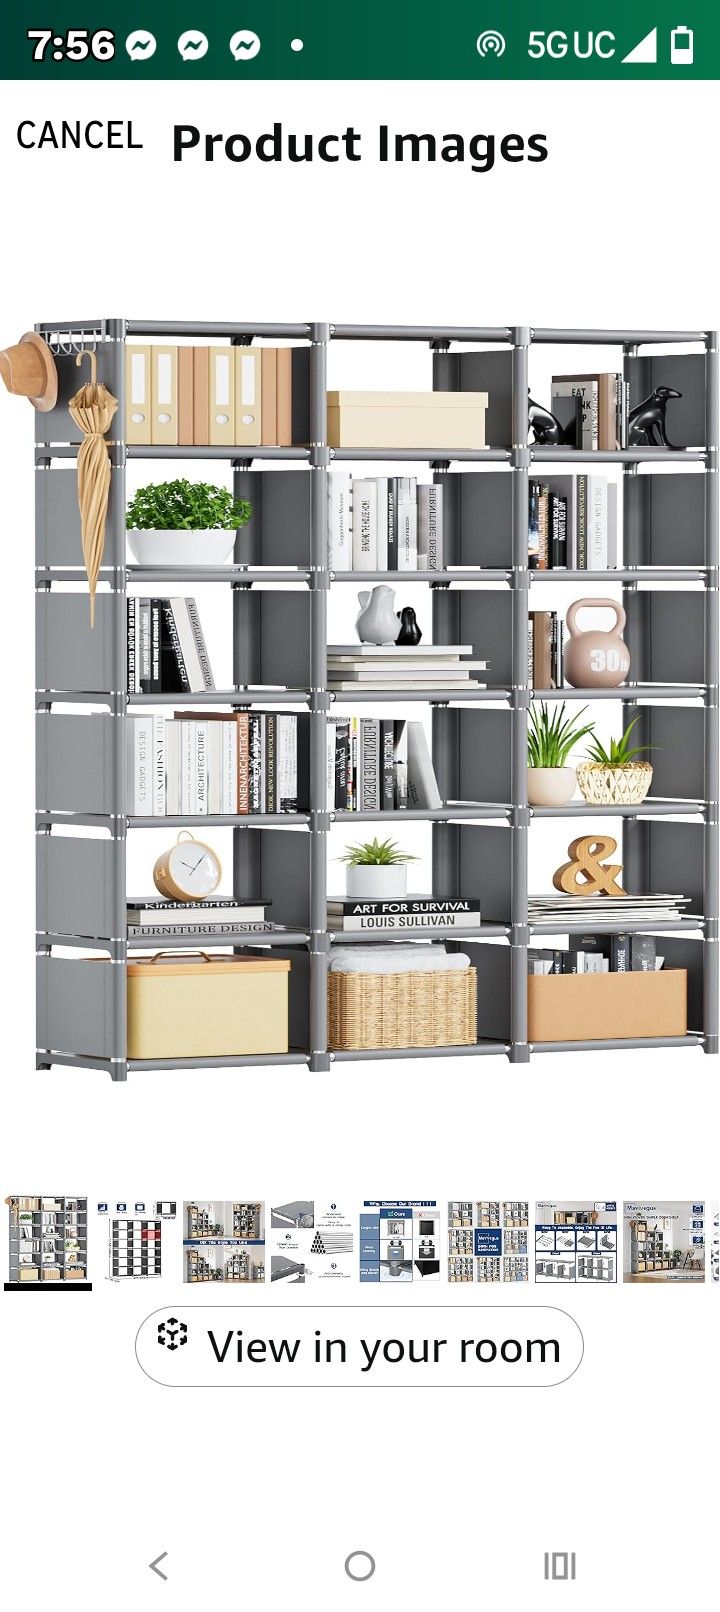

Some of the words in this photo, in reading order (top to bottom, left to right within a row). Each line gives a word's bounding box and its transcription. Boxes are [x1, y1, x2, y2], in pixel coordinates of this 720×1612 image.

[27, 28, 115, 62] 7:56
[16, 120, 143, 149] CANCEL
[172, 124, 361, 163] Product
[378, 125, 549, 172] Images
[571, 388, 586, 397] EAT
[590, 649, 620, 672] 30
[240, 716, 248, 811] INNENARCHITEKTUR
[145, 901, 239, 910] Kindergarten
[353, 904, 378, 914] ART
[382, 903, 409, 913] FOR
[412, 902, 470, 912] SURVIVAL
[132, 925, 216, 935] FURNITURE
[220, 924, 273, 933] DESIGN
[360, 917, 395, 928] LOUIS
[399, 915, 455, 927] SULLIVAN
[207, 1330, 301, 1363] View
[314, 1330, 346, 1363] in
[360, 1338, 446, 1372] your
[460, 1338, 560, 1363] room
